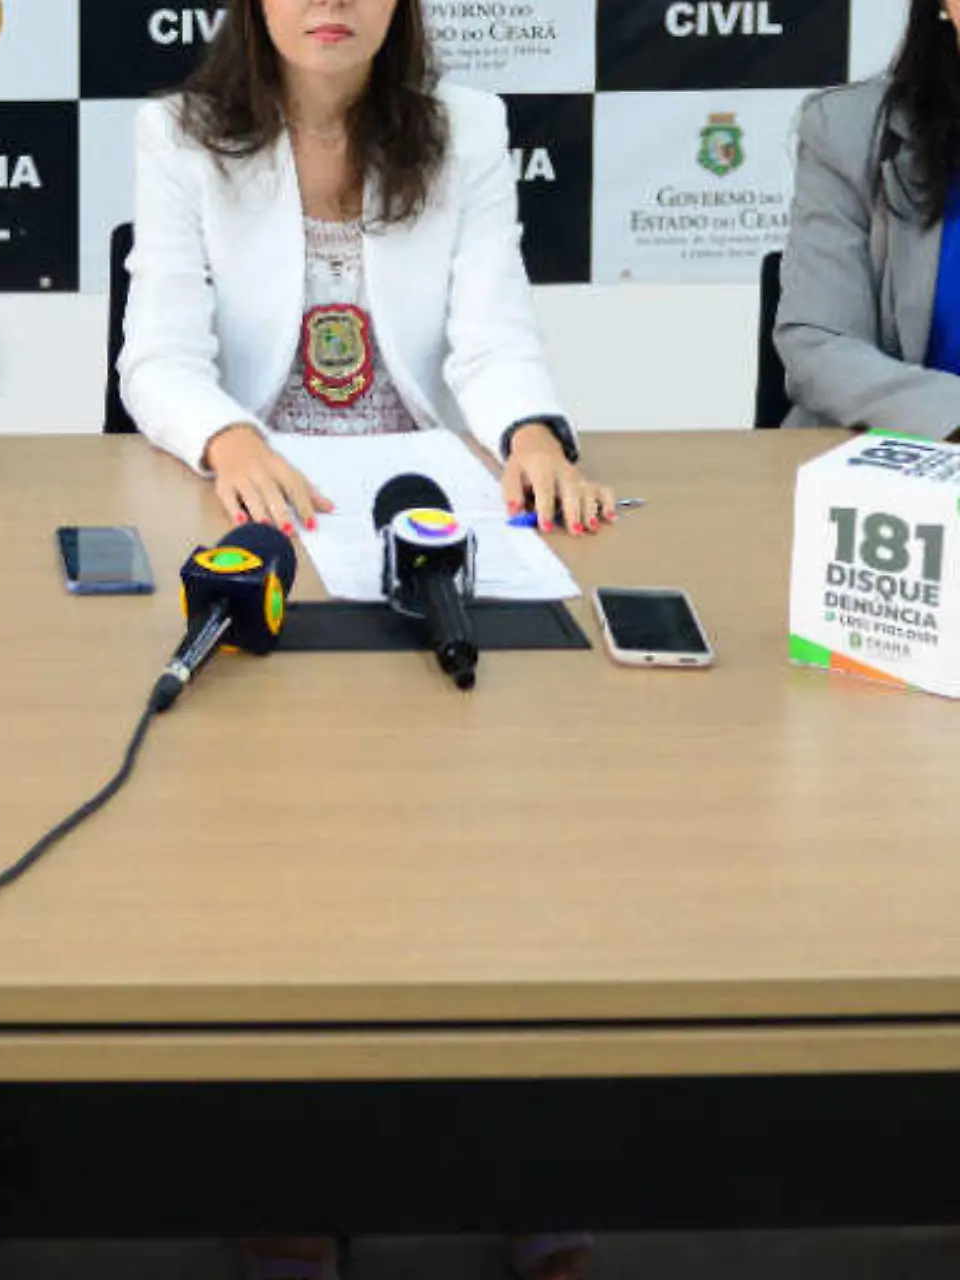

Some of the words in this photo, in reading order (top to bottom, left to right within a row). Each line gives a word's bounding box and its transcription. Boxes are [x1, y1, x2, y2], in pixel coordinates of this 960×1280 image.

[148, 8, 228, 44] CIV
[666, 1, 782, 36] CIVIL
[829, 506, 945, 582] 181
[826, 563, 941, 607] DISQUE
